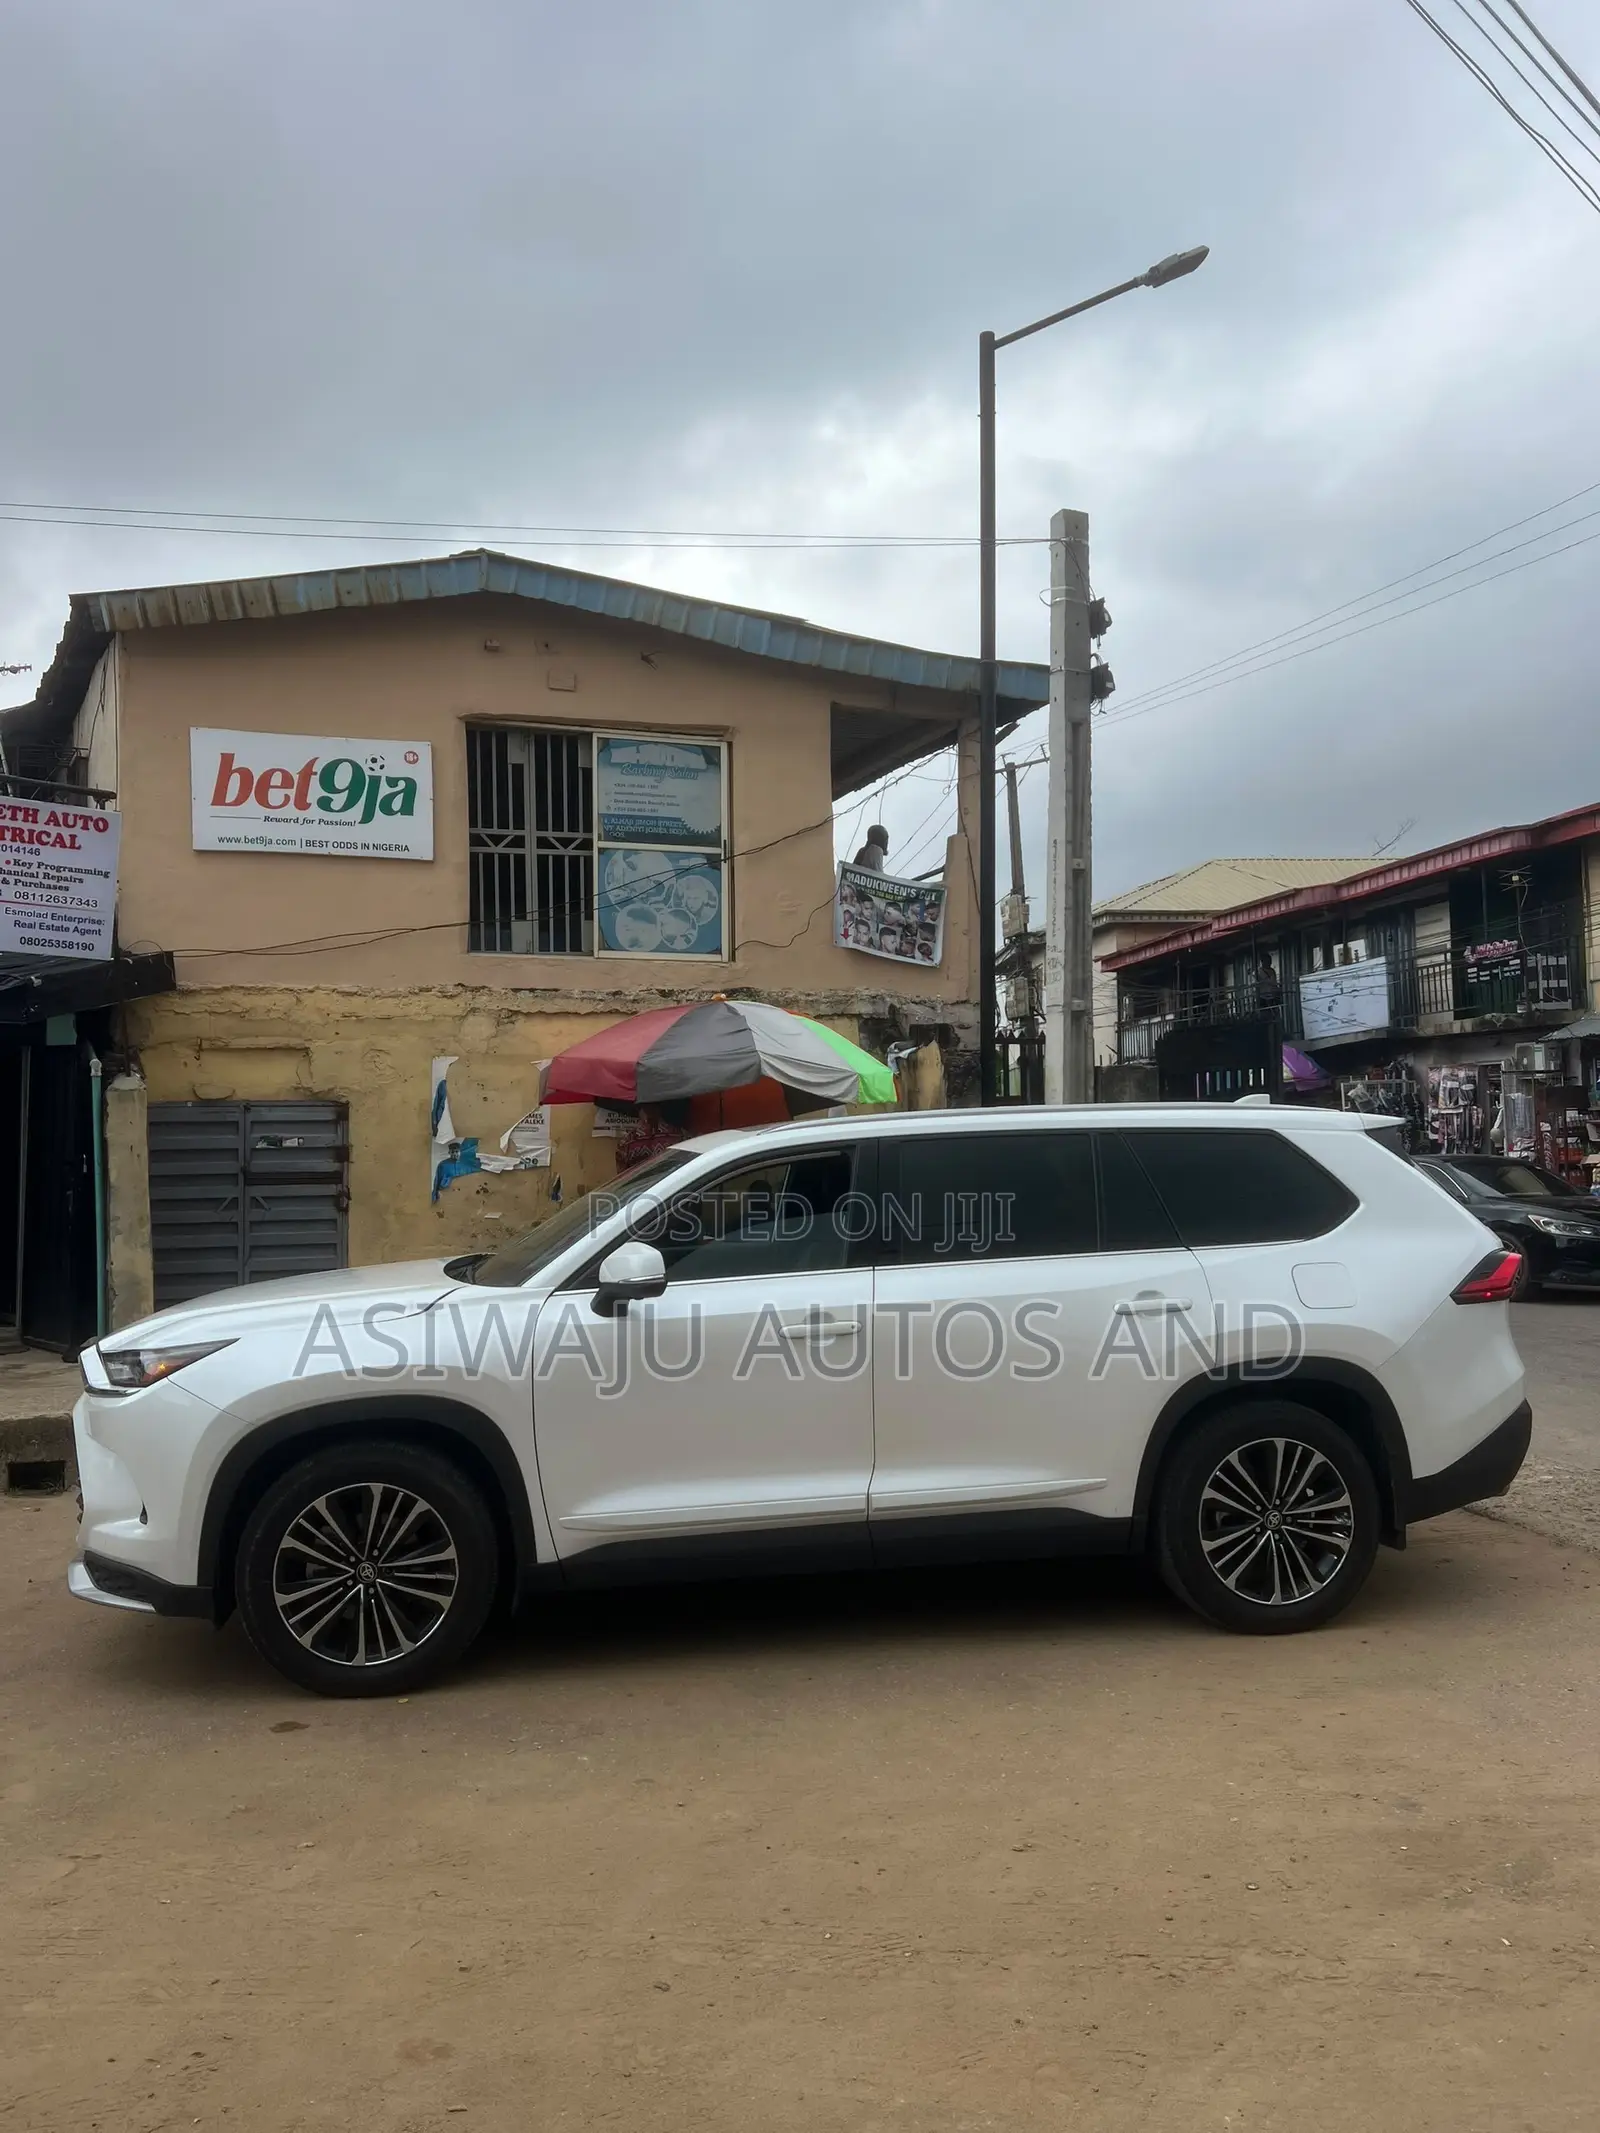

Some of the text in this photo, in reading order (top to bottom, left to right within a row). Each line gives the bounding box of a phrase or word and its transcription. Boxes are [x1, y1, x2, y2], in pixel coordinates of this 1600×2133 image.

[210, 753, 418, 824] bet9ja
[44, 810, 109, 833] AUTO
[263, 815, 357, 827] Reward for Passion!
[0, 825, 81, 850] TRICAL
[217, 835, 410, 853] www.bet9ja.com BEST ODDS IN NIGERIA
[0, 844, 41, 856] 014146
[12, 858, 111, 879] Key Programming
[42, 871, 84, 884] Repairs
[1, 877, 70, 892] & Purchases
[14, 890, 98, 908] 08112637343
[4, 906, 105, 926] Esmolad Enterprise:
[13, 919, 102, 936] Real Estate Agent
[19, 936, 95, 951] 08025358190
